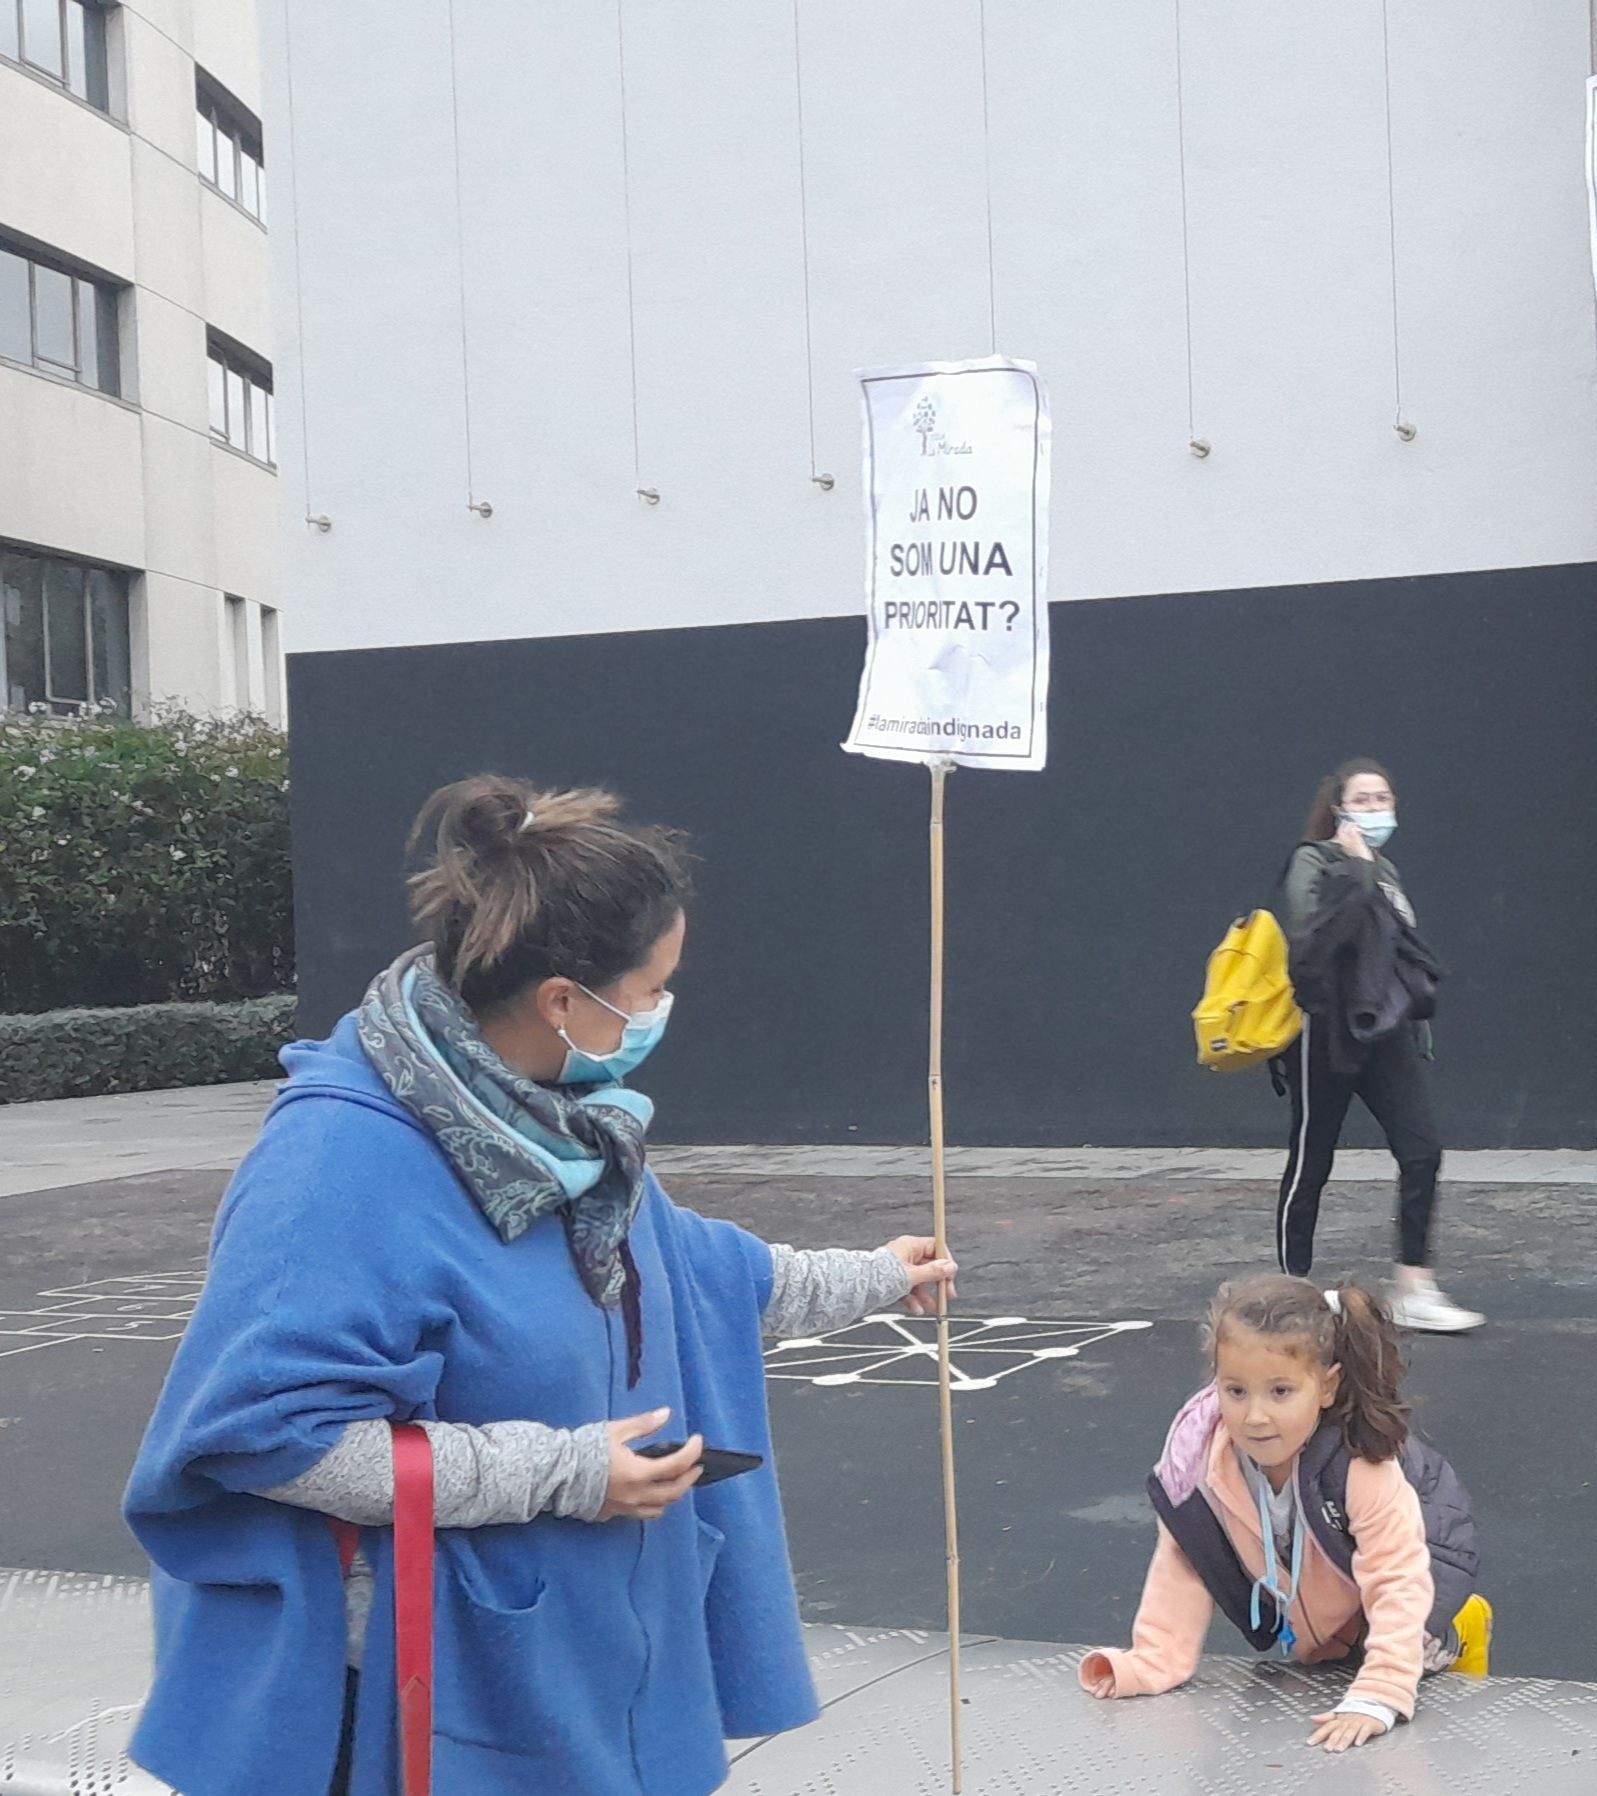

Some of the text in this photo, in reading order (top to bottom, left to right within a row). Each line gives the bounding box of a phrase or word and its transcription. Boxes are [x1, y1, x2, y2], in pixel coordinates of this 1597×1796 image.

[909, 486, 977, 522] JA NO
[890, 542, 1013, 577] SOM UNA
[885, 600, 1020, 632] PRIORITAT?
